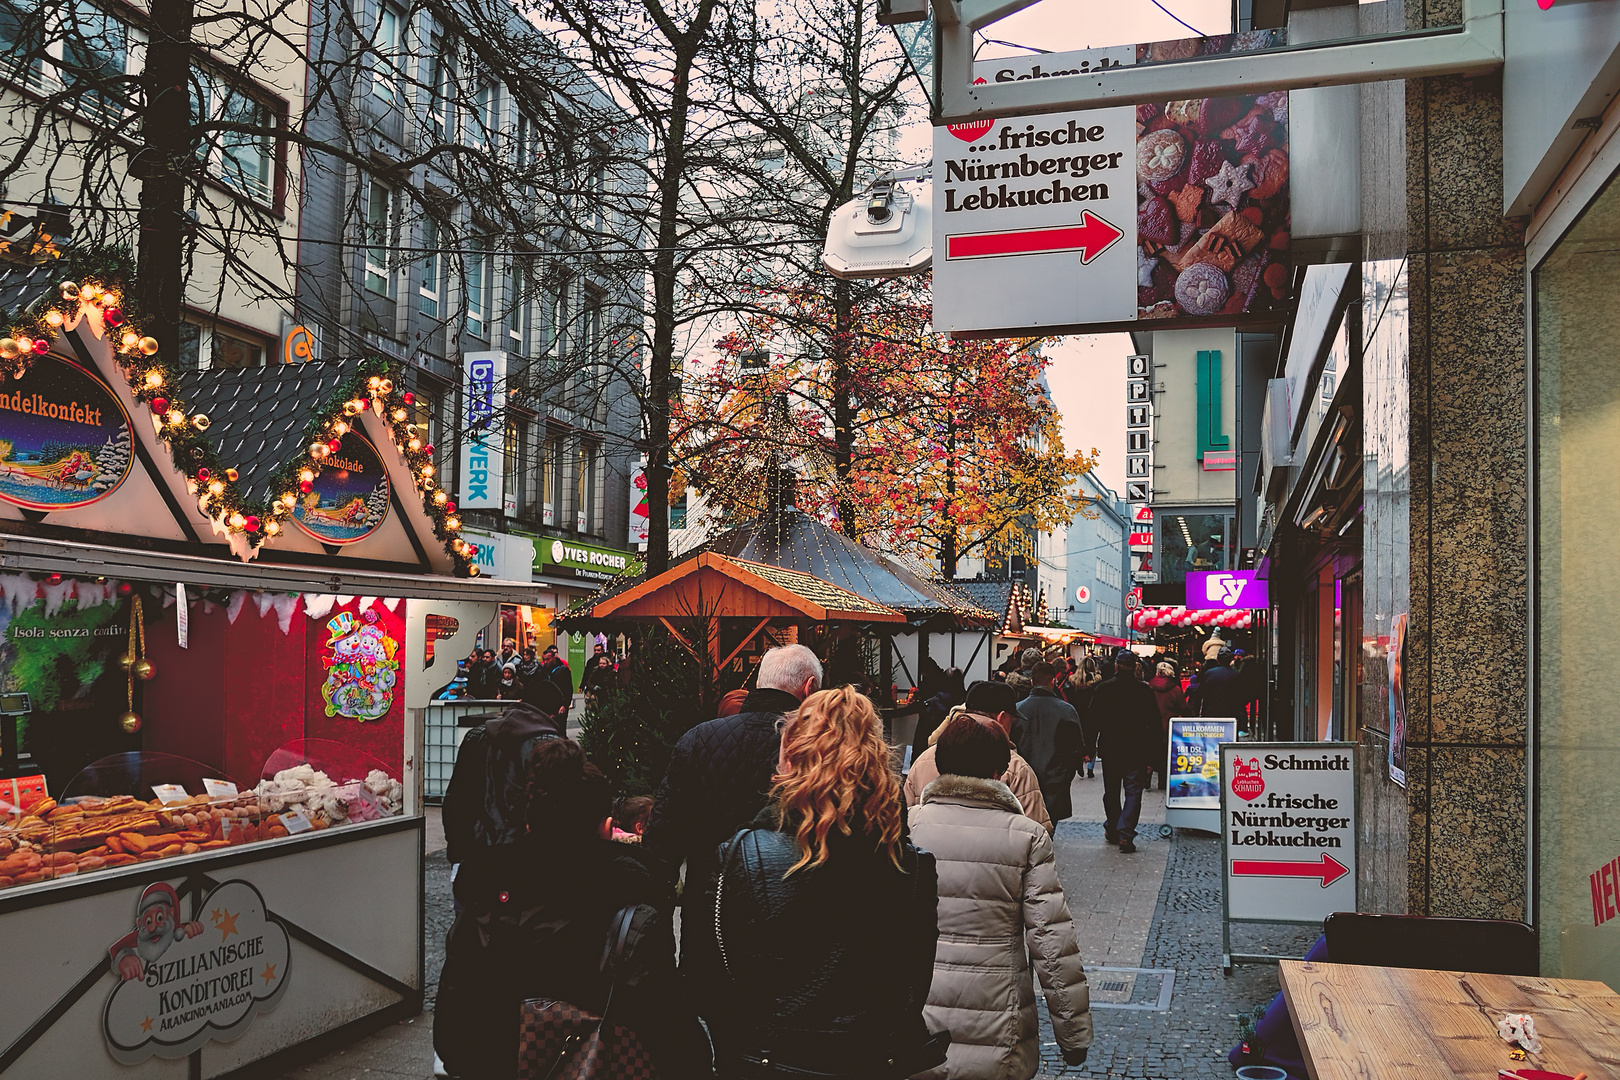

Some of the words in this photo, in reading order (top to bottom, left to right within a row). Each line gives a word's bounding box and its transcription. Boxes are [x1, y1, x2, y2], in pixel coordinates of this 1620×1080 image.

[968, 119, 1105, 153] ...frische
[944, 150, 1123, 184] Nürnberger
[944, 179, 1110, 213] Lebkuchen
[1130, 356, 1147, 476] OPTIK
[469, 542, 495, 567] ERK
[564, 547, 588, 564] YVES
[590, 553, 626, 569] ROCHER
[14, 626, 45, 638] Isola
[49, 628, 89, 638] senza
[1182, 725, 1225, 733] WILLKOMMEN
[1176, 755, 1203, 773] 9,99
[1264, 754, 1350, 771] Schmidt
[1234, 784, 1262, 793] SCHMIDT
[1247, 792, 1338, 810] ...frische
[1231, 810, 1350, 832] Nürnberger
[1231, 830, 1342, 848] Lebkuchen
[146, 935, 264, 988] SIZILIANISCHE
[159, 966, 254, 1016] KONDITOREI
[160, 990, 252, 1032] ARANCINOMANIA.COM
